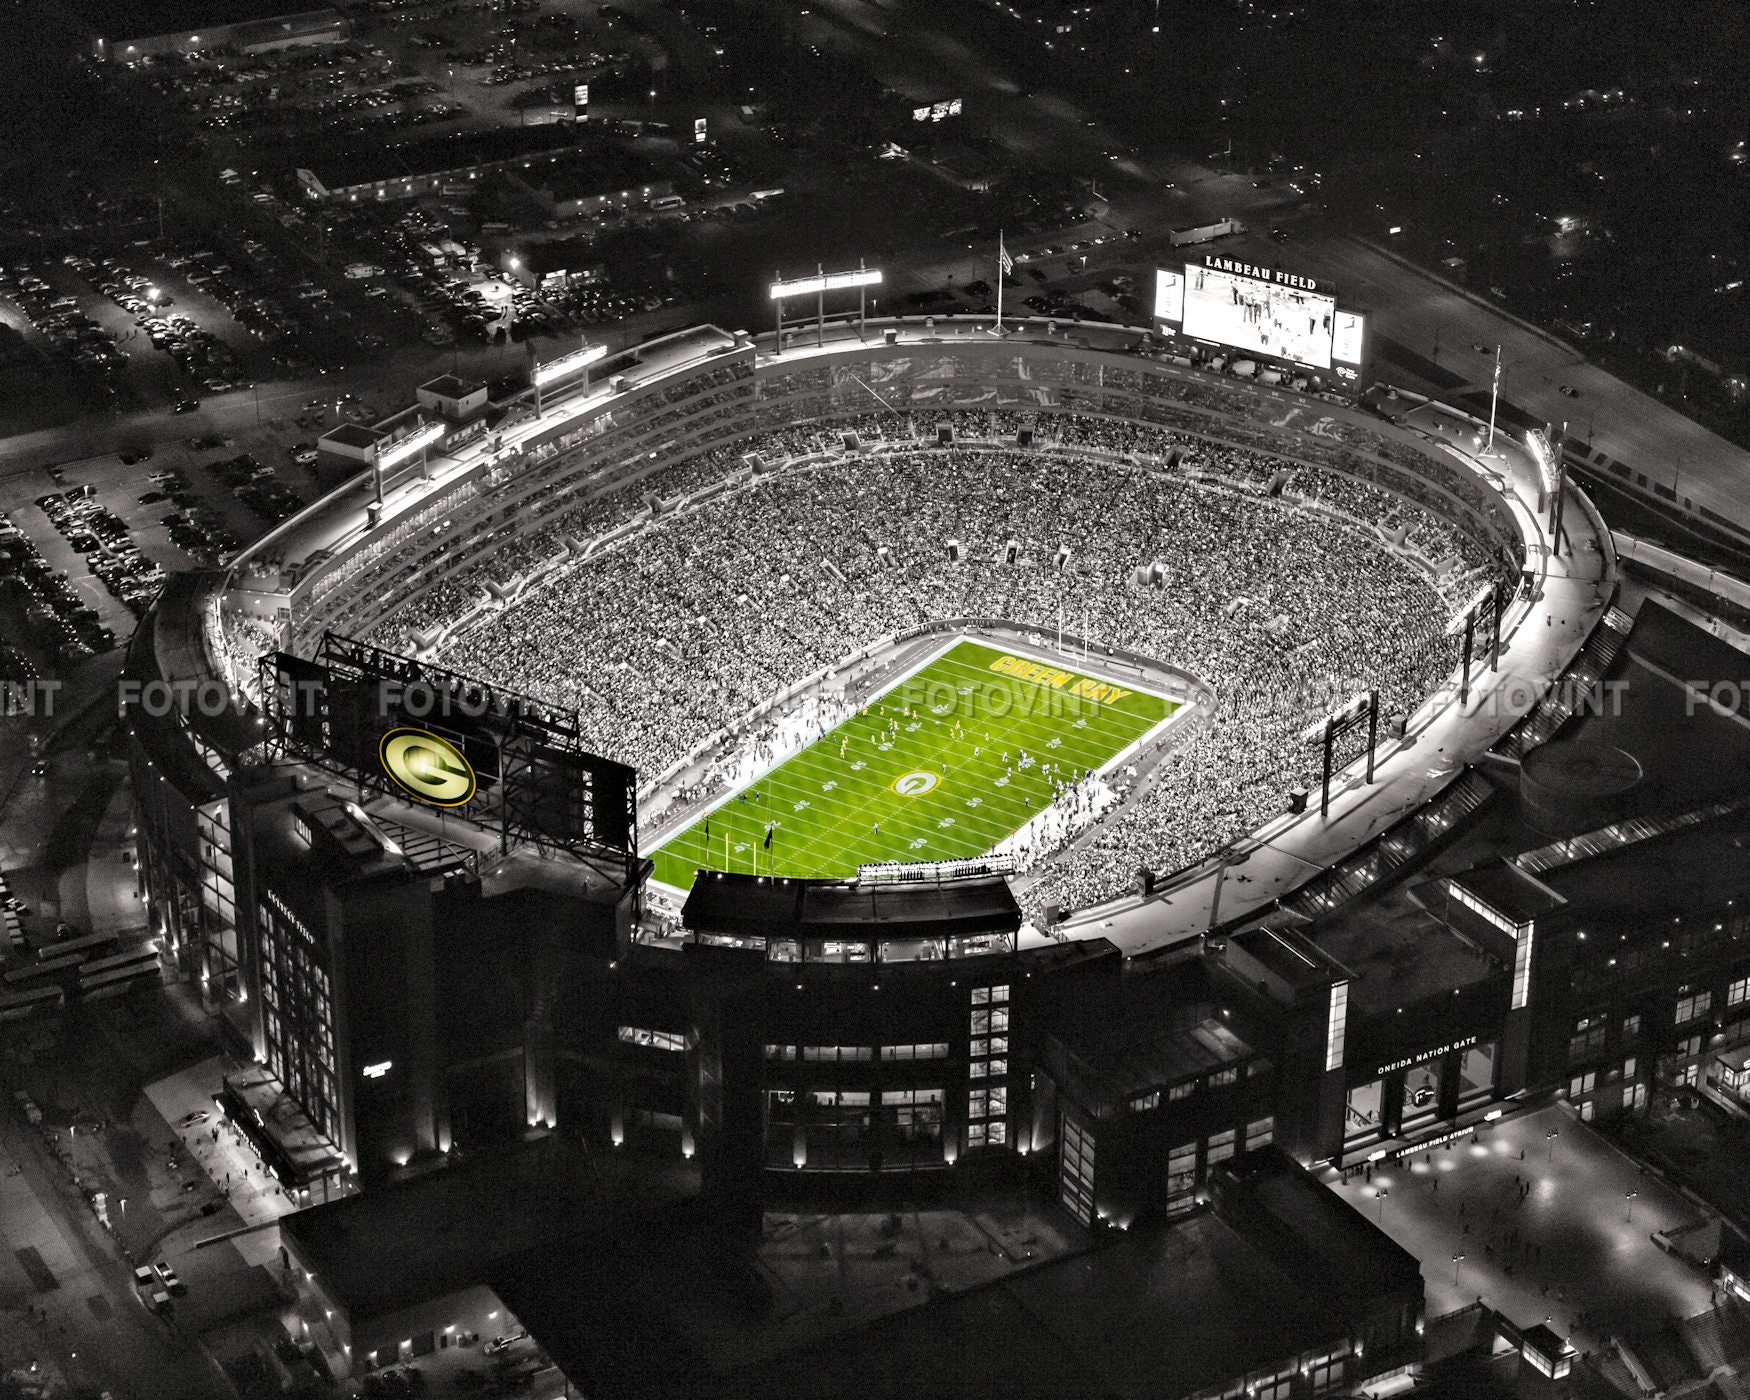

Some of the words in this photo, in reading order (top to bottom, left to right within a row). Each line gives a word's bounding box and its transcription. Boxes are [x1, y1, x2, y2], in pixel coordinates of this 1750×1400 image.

[1205, 255, 1270, 280] LAMBEAU
[1275, 271, 1316, 290] FIELD
[989, 655, 1075, 689] GREEN
[1068, 678, 1133, 705] BAY
[1377, 1058, 1412, 1074] ONEIDA
[1416, 1045, 1450, 1063] NATION
[1453, 1036, 1477, 1050] GATE
